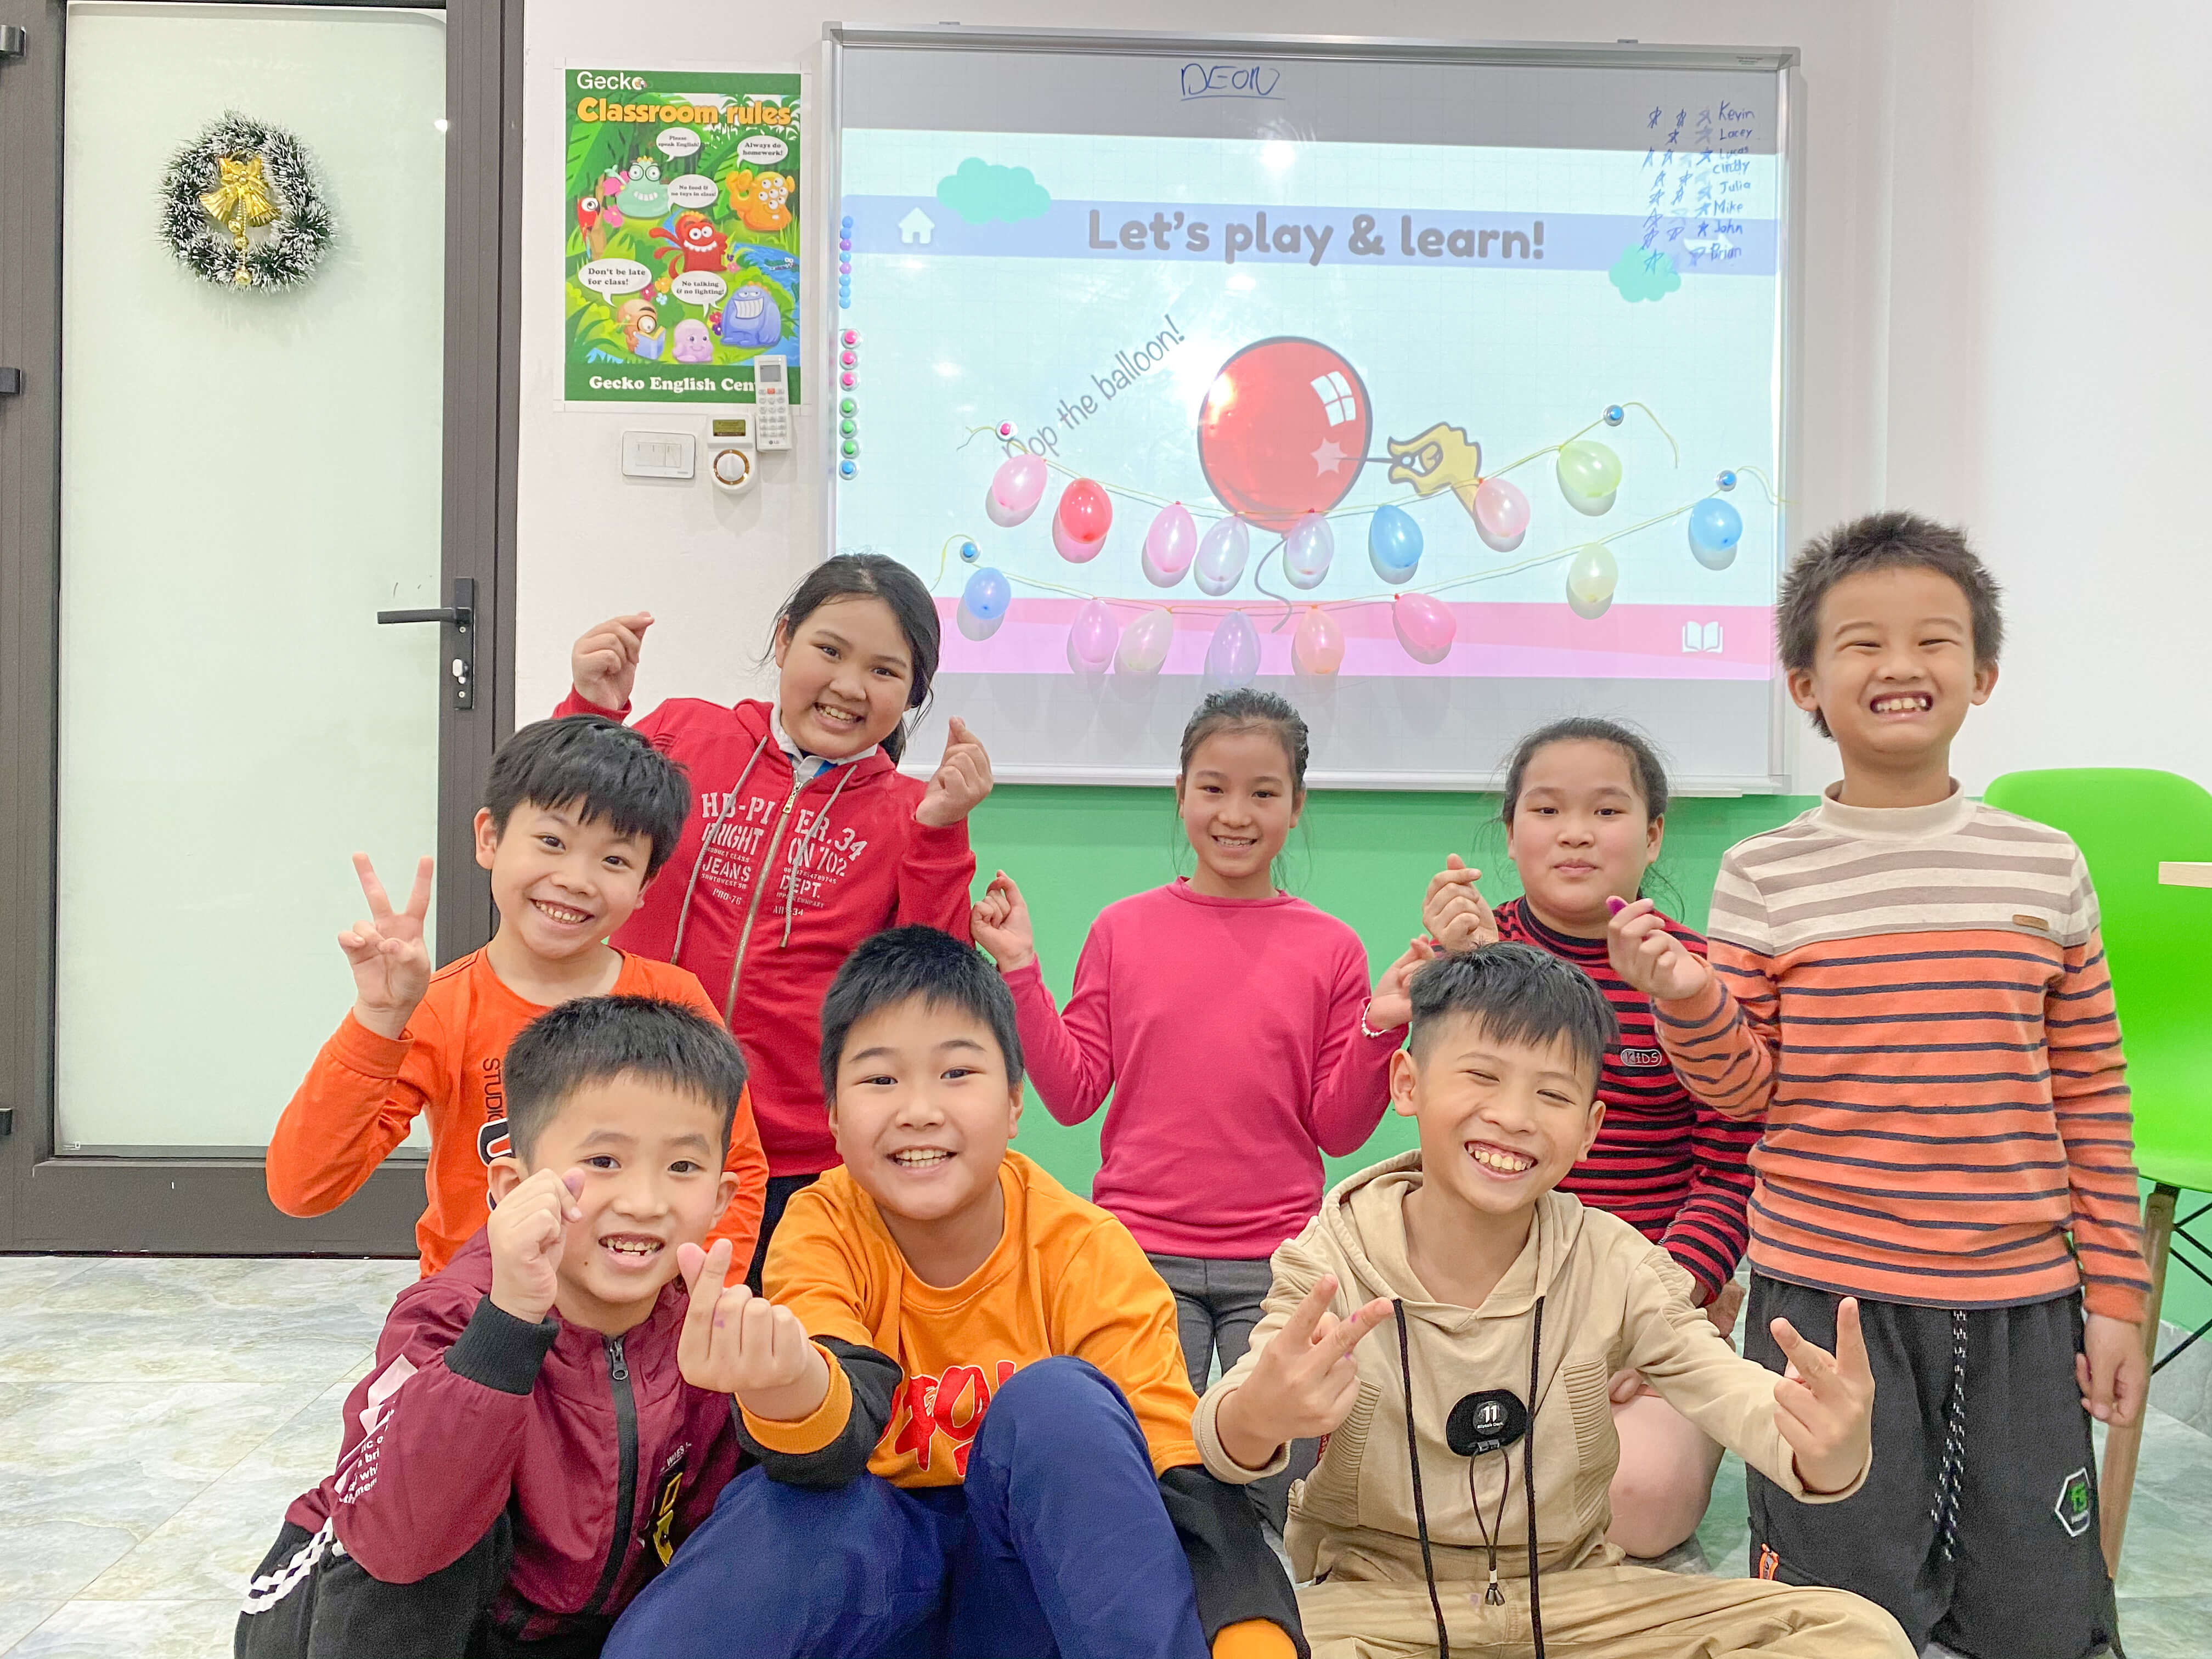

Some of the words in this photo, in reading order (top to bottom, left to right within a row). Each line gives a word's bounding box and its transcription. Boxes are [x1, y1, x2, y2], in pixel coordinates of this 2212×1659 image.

[577, 97, 718, 125] Classroom
[727, 100, 791, 125] rules
[1719, 100, 1754, 121] Kevin
[1720, 180, 1751, 194] Julia
[1713, 199, 1743, 216] Mike
[1714, 218, 1742, 234] John
[1225, 212, 1333, 266] play
[1348, 213, 1385, 256] &
[1401, 215, 1544, 260] learn!
[1057, 399, 1098, 430] the
[1091, 314, 1185, 400] balloon!
[589, 376, 645, 390] Gecko
[650, 376, 716, 394] English
[721, 377, 755, 392] Cen
[702, 856, 752, 882] JEANS
[779, 874, 822, 899] DEPT.
[1483, 1404, 1497, 1423] 11
